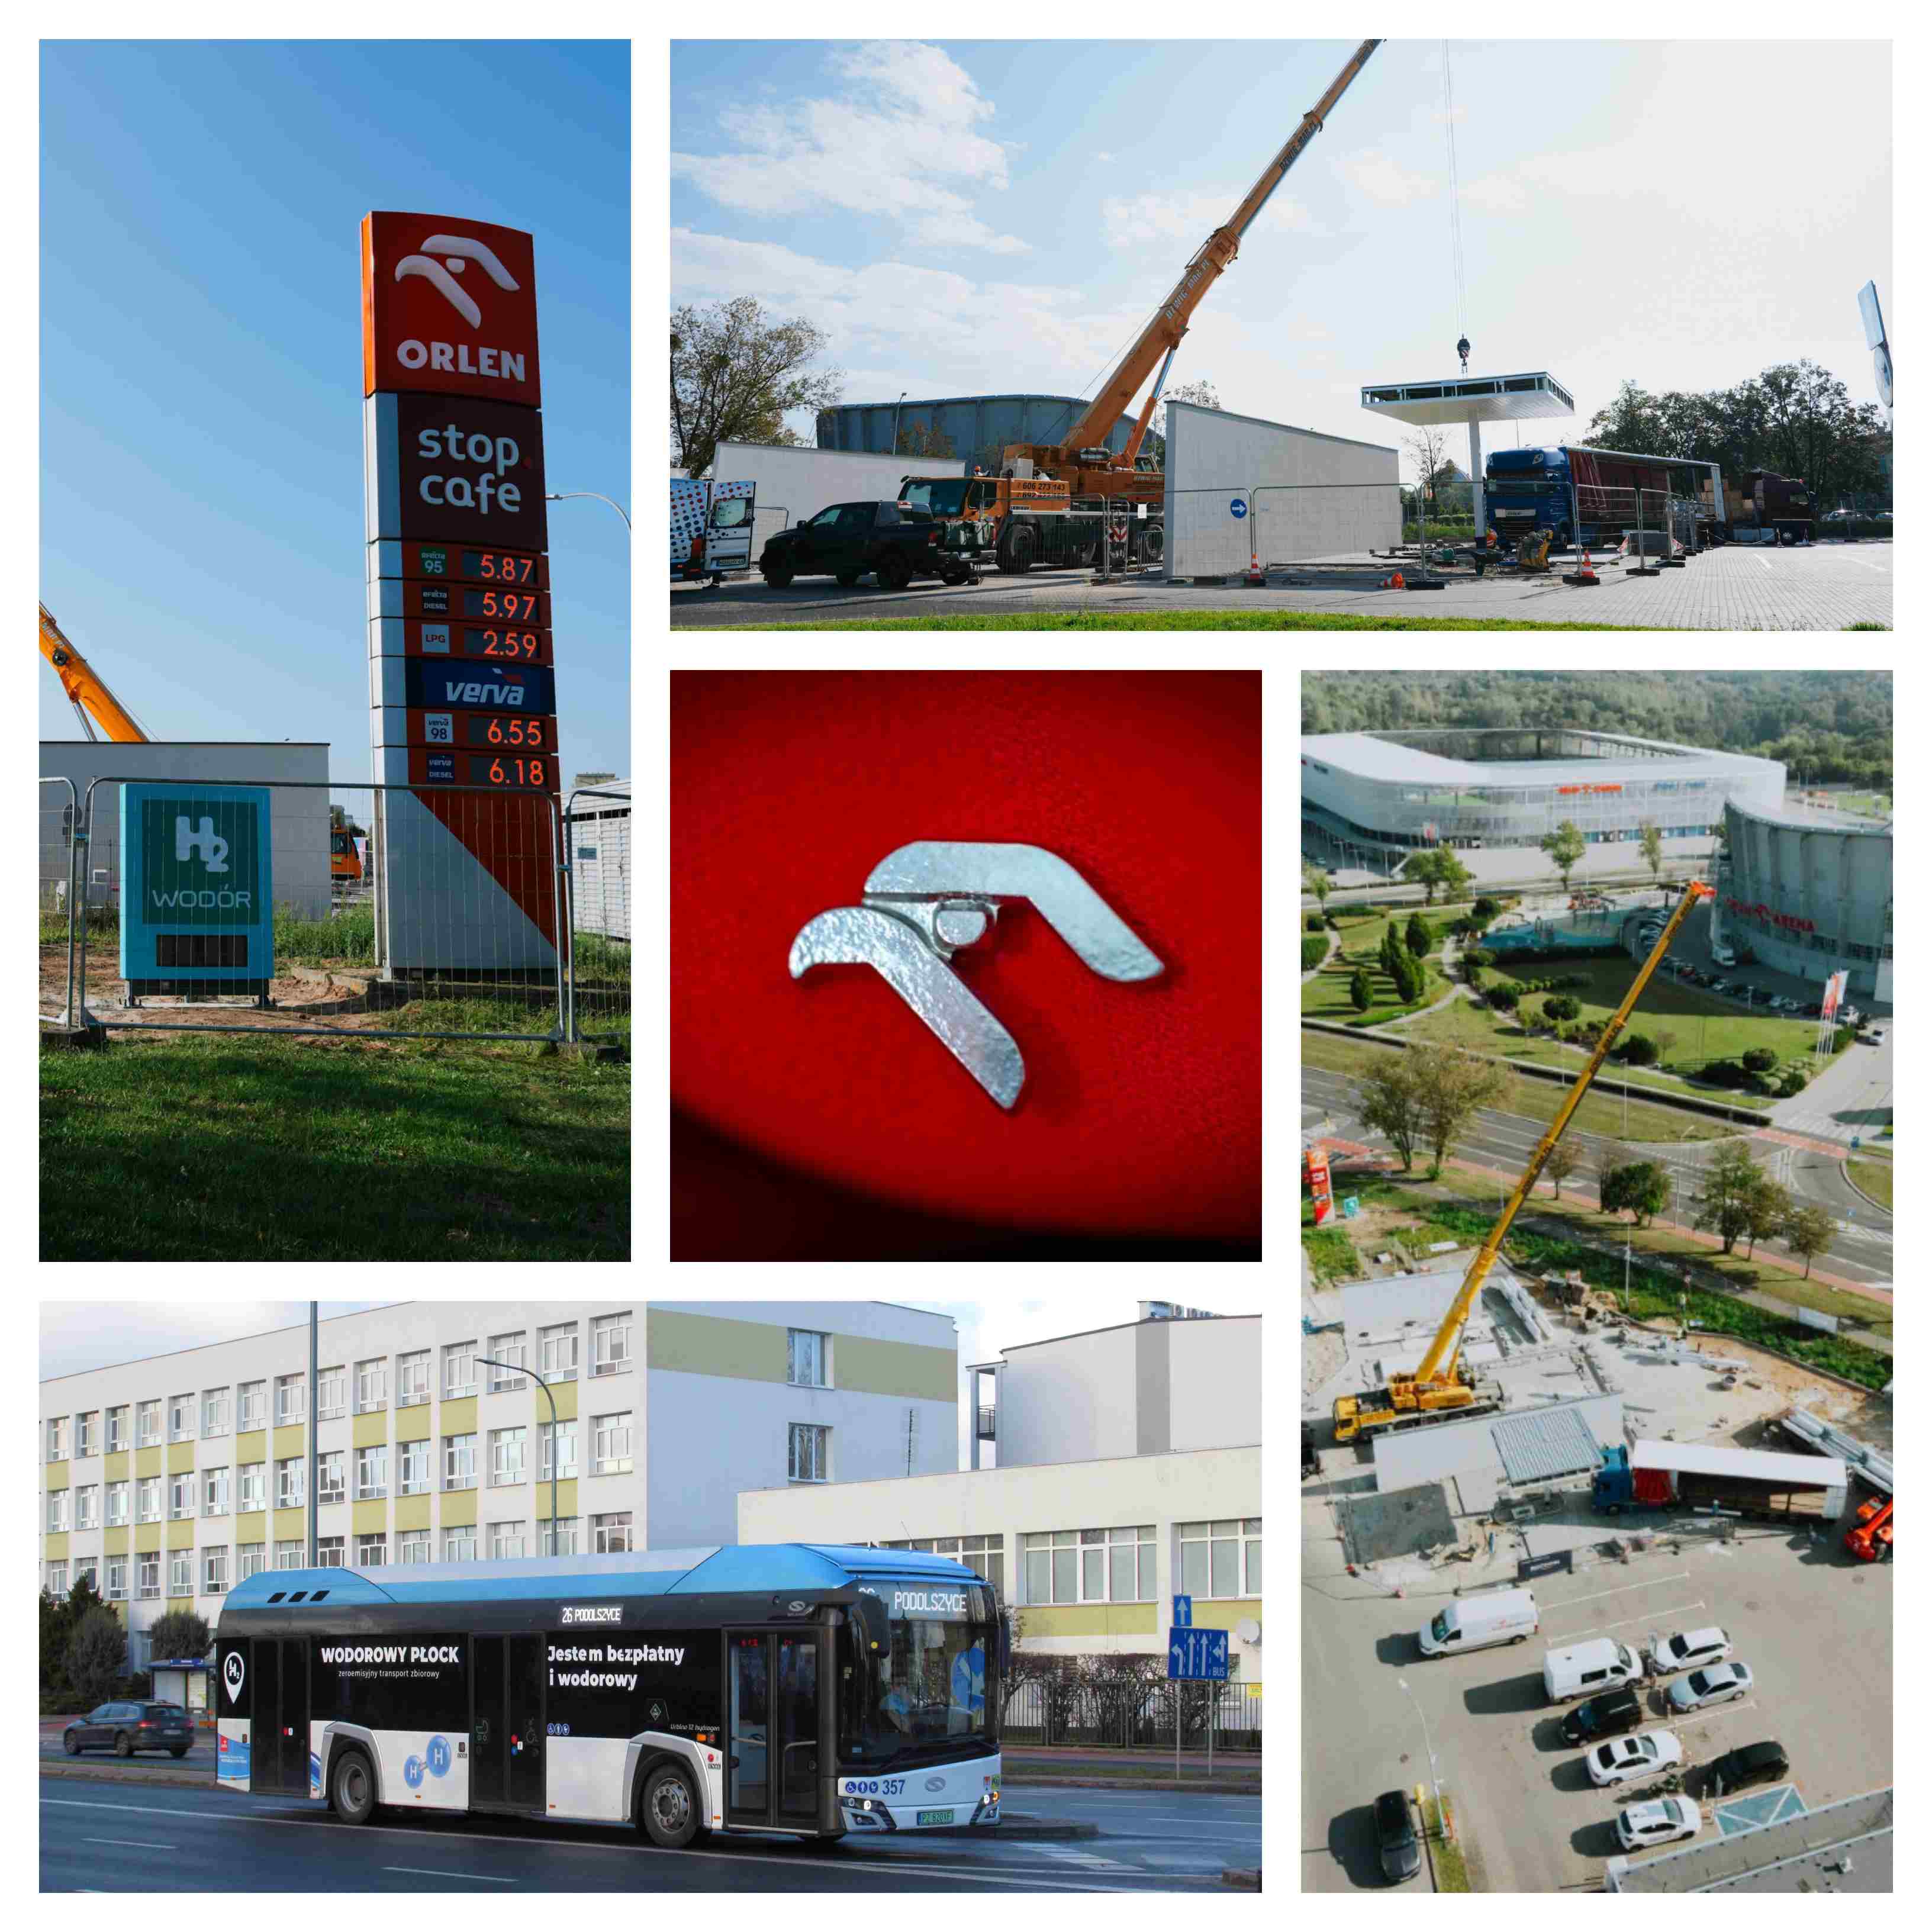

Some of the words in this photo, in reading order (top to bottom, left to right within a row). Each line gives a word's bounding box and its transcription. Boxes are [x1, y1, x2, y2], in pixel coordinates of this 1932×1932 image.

[397, 339, 526, 382] ORLEN
[418, 424, 520, 476] stop
[420, 473, 521, 514] cafe
[424, 560, 443, 574] 95
[480, 553, 533, 582] 5.87
[482, 592, 536, 620] 5.97
[426, 634, 446, 643] LPG
[482, 630, 537, 658] 2.59
[446, 681, 524, 705] verva
[430, 728, 447, 740] 98
[487, 719, 542, 746] 6.55
[489, 758, 544, 785] 6.18
[152, 884, 252, 909] WODÓR
[894, 1590, 967, 1612] PODOLSZYCE
[562, 1607, 573, 1623] 26
[574, 1608, 622, 1622] PODOLSZYCE
[321, 1646, 407, 1663] WODOROWY
[410, 1646, 459, 1663] PŁOCK
[548, 1646, 603, 1661] Jestem
[607, 1644, 685, 1666] bezpłatny
[338, 1669, 378, 1679] zeroemisyjny
[379, 1669, 408, 1679] transport
[410, 1669, 440, 1679] zbiorowy
[549, 1667, 555, 1686] i
[558, 1670, 638, 1691] wodorowy
[1212, 1666, 1225, 1677] BUS
[694, 1724, 720, 1733] hydrogen
[434, 1747, 444, 1766] H
[410, 1764, 417, 1779] H
[881, 1779, 907, 1795] 357
